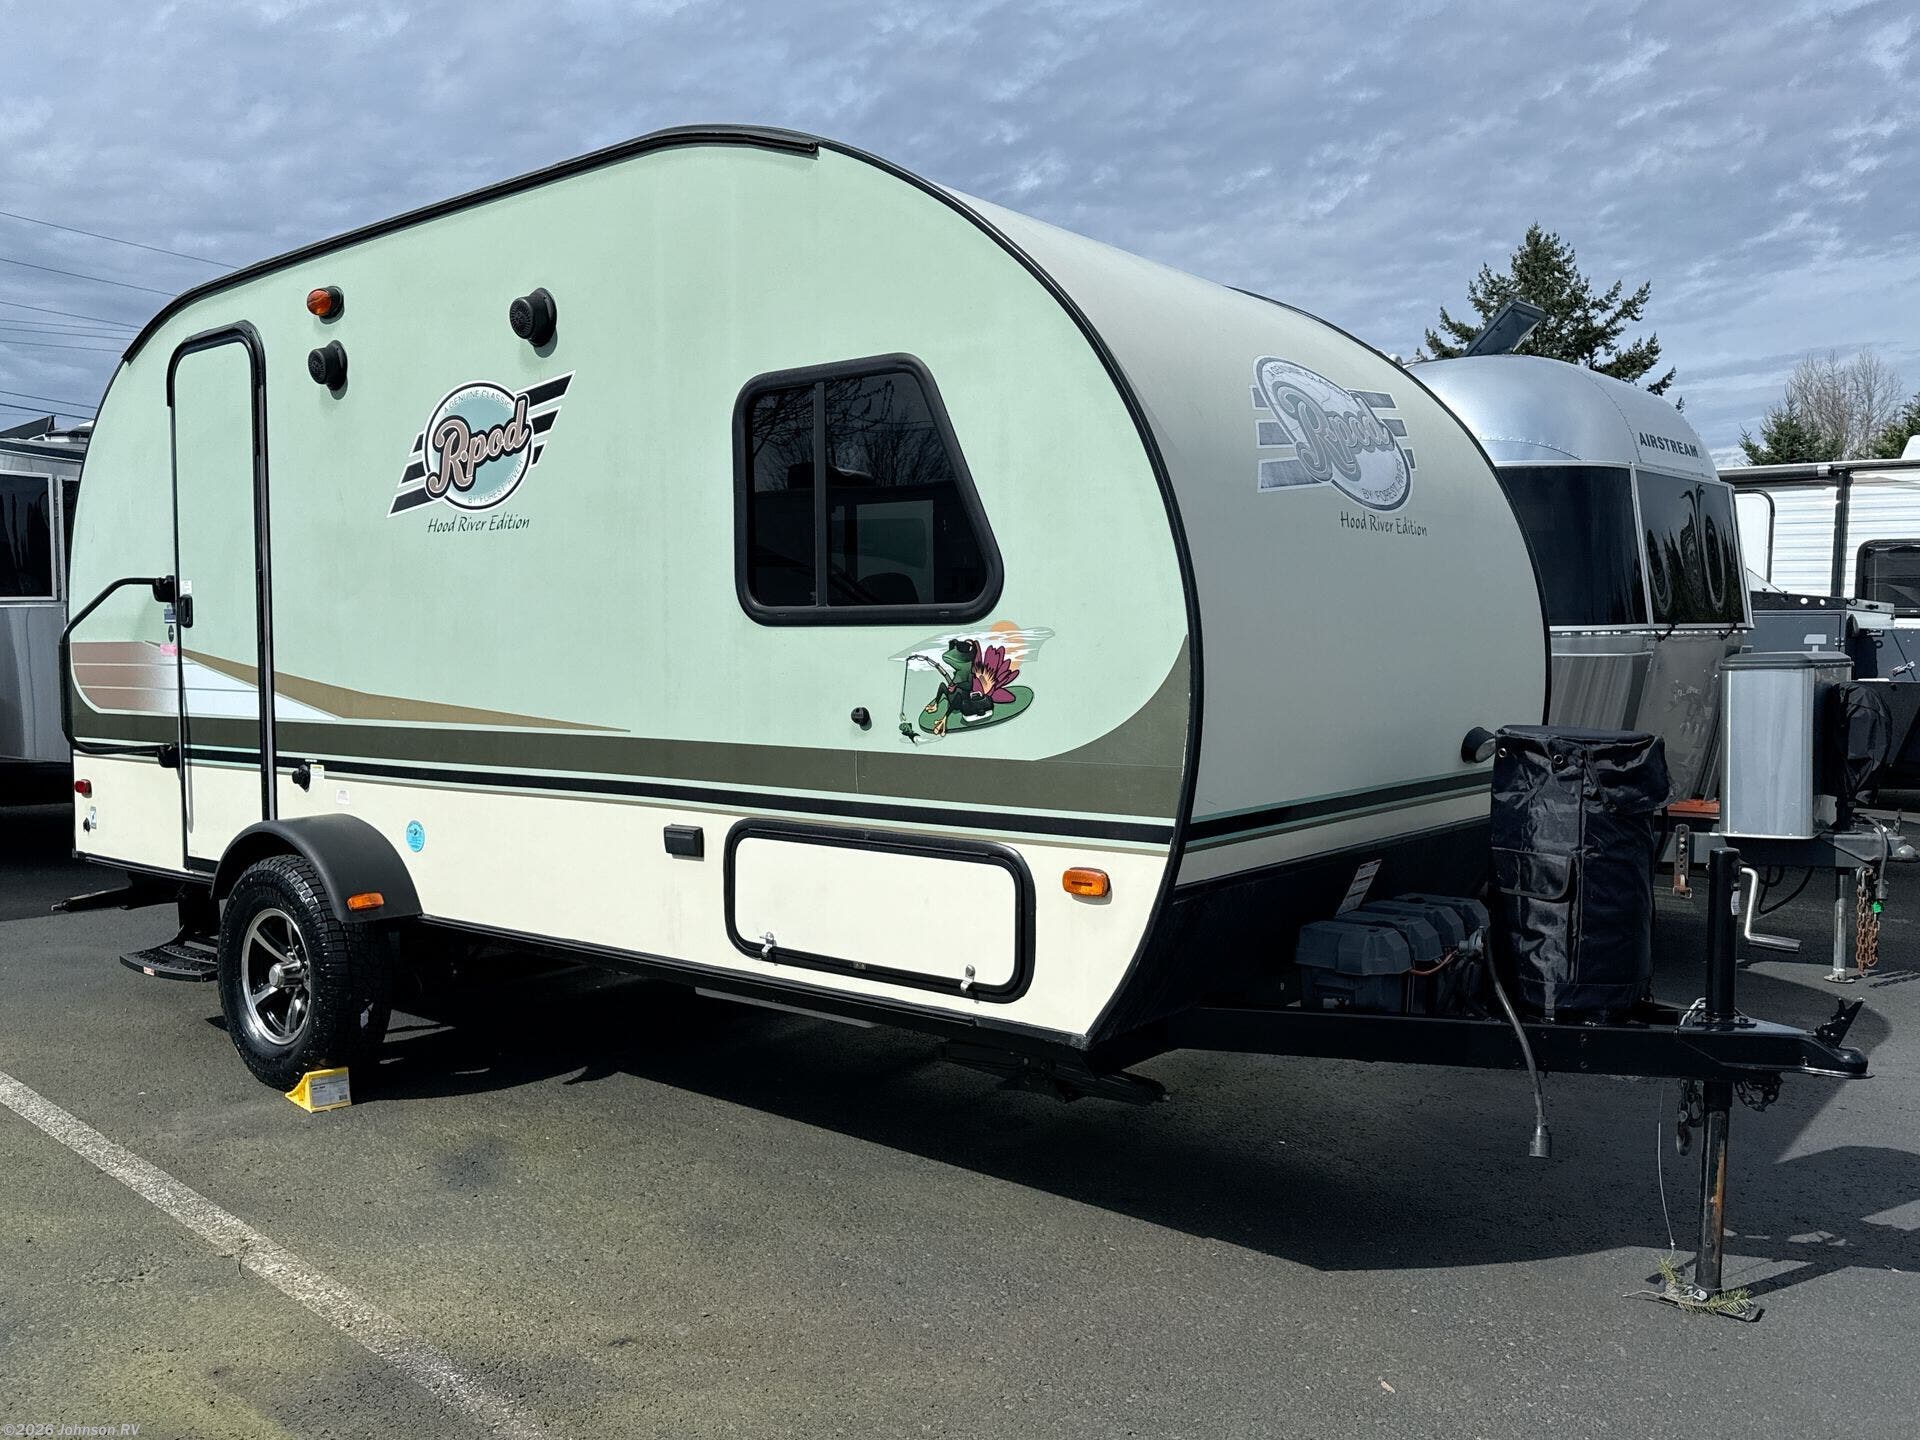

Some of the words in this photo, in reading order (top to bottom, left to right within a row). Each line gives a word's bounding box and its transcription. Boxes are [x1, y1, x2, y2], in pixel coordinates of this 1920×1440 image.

[481, 390, 512, 409] CLASSIC
[1639, 432, 1699, 458] AIRSTREAM
[427, 514, 458, 533] Hood
[458, 516, 487, 532] River
[488, 511, 530, 531] Edition
[1340, 511, 1367, 530] Hood
[1369, 514, 1393, 532] River
[1395, 516, 1428, 536] Edition
